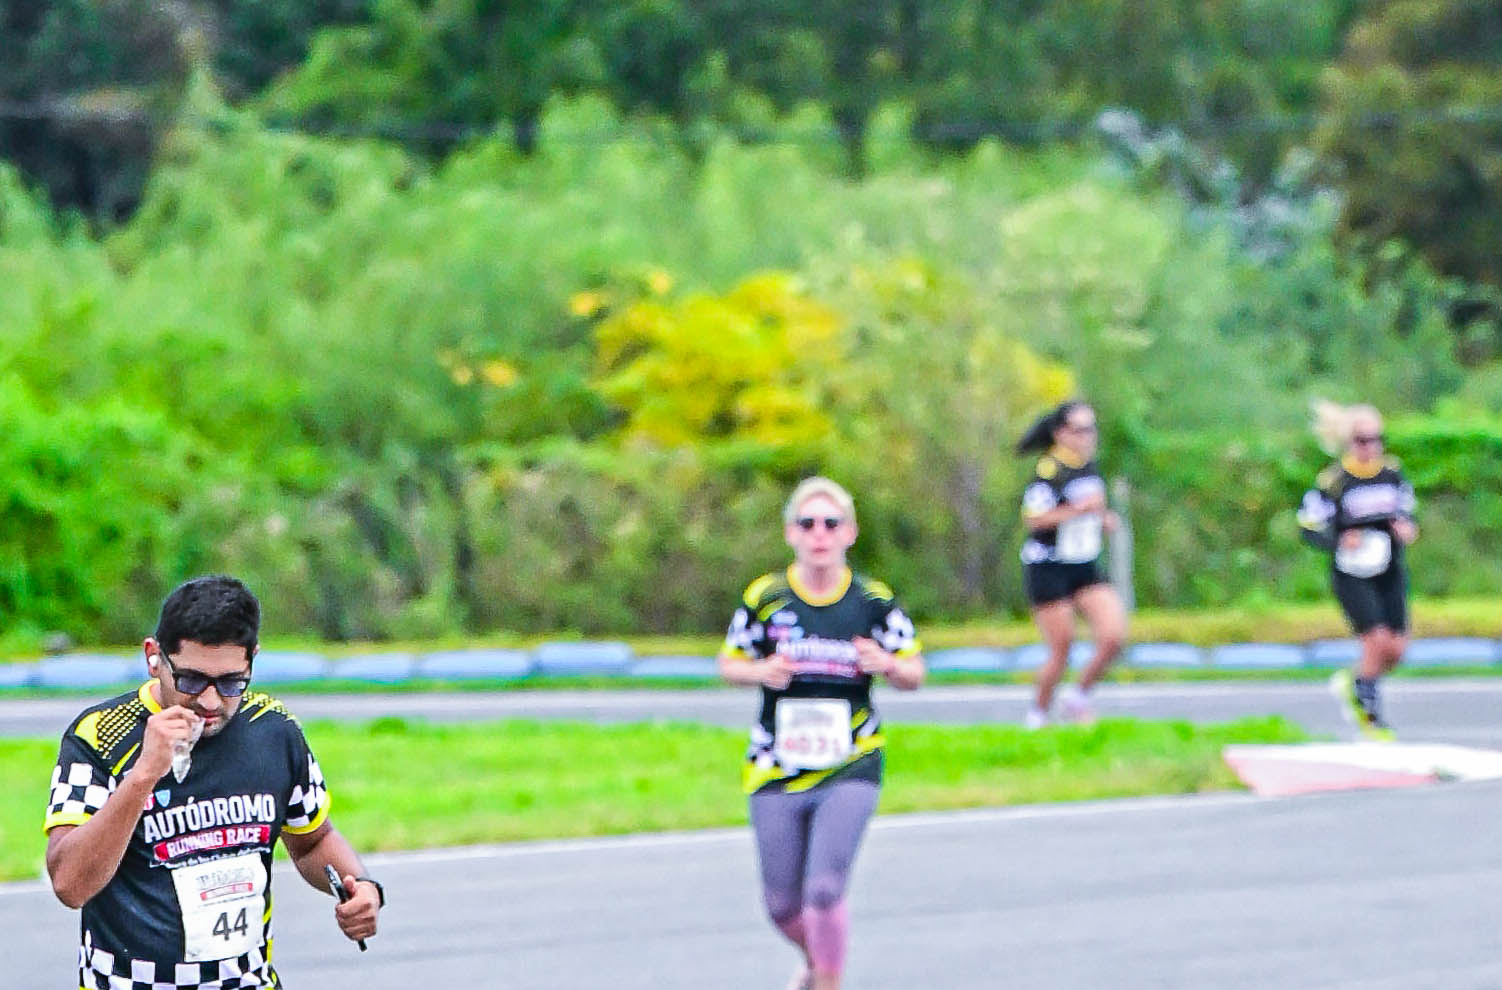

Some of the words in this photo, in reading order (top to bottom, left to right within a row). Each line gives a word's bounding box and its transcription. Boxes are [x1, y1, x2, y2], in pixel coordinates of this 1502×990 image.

[143, 793, 276, 844] AUTÓDROMO
[166, 831, 224, 858] RUNNING
[225, 827, 262, 845] RACE
[212, 907, 248, 941] 44
